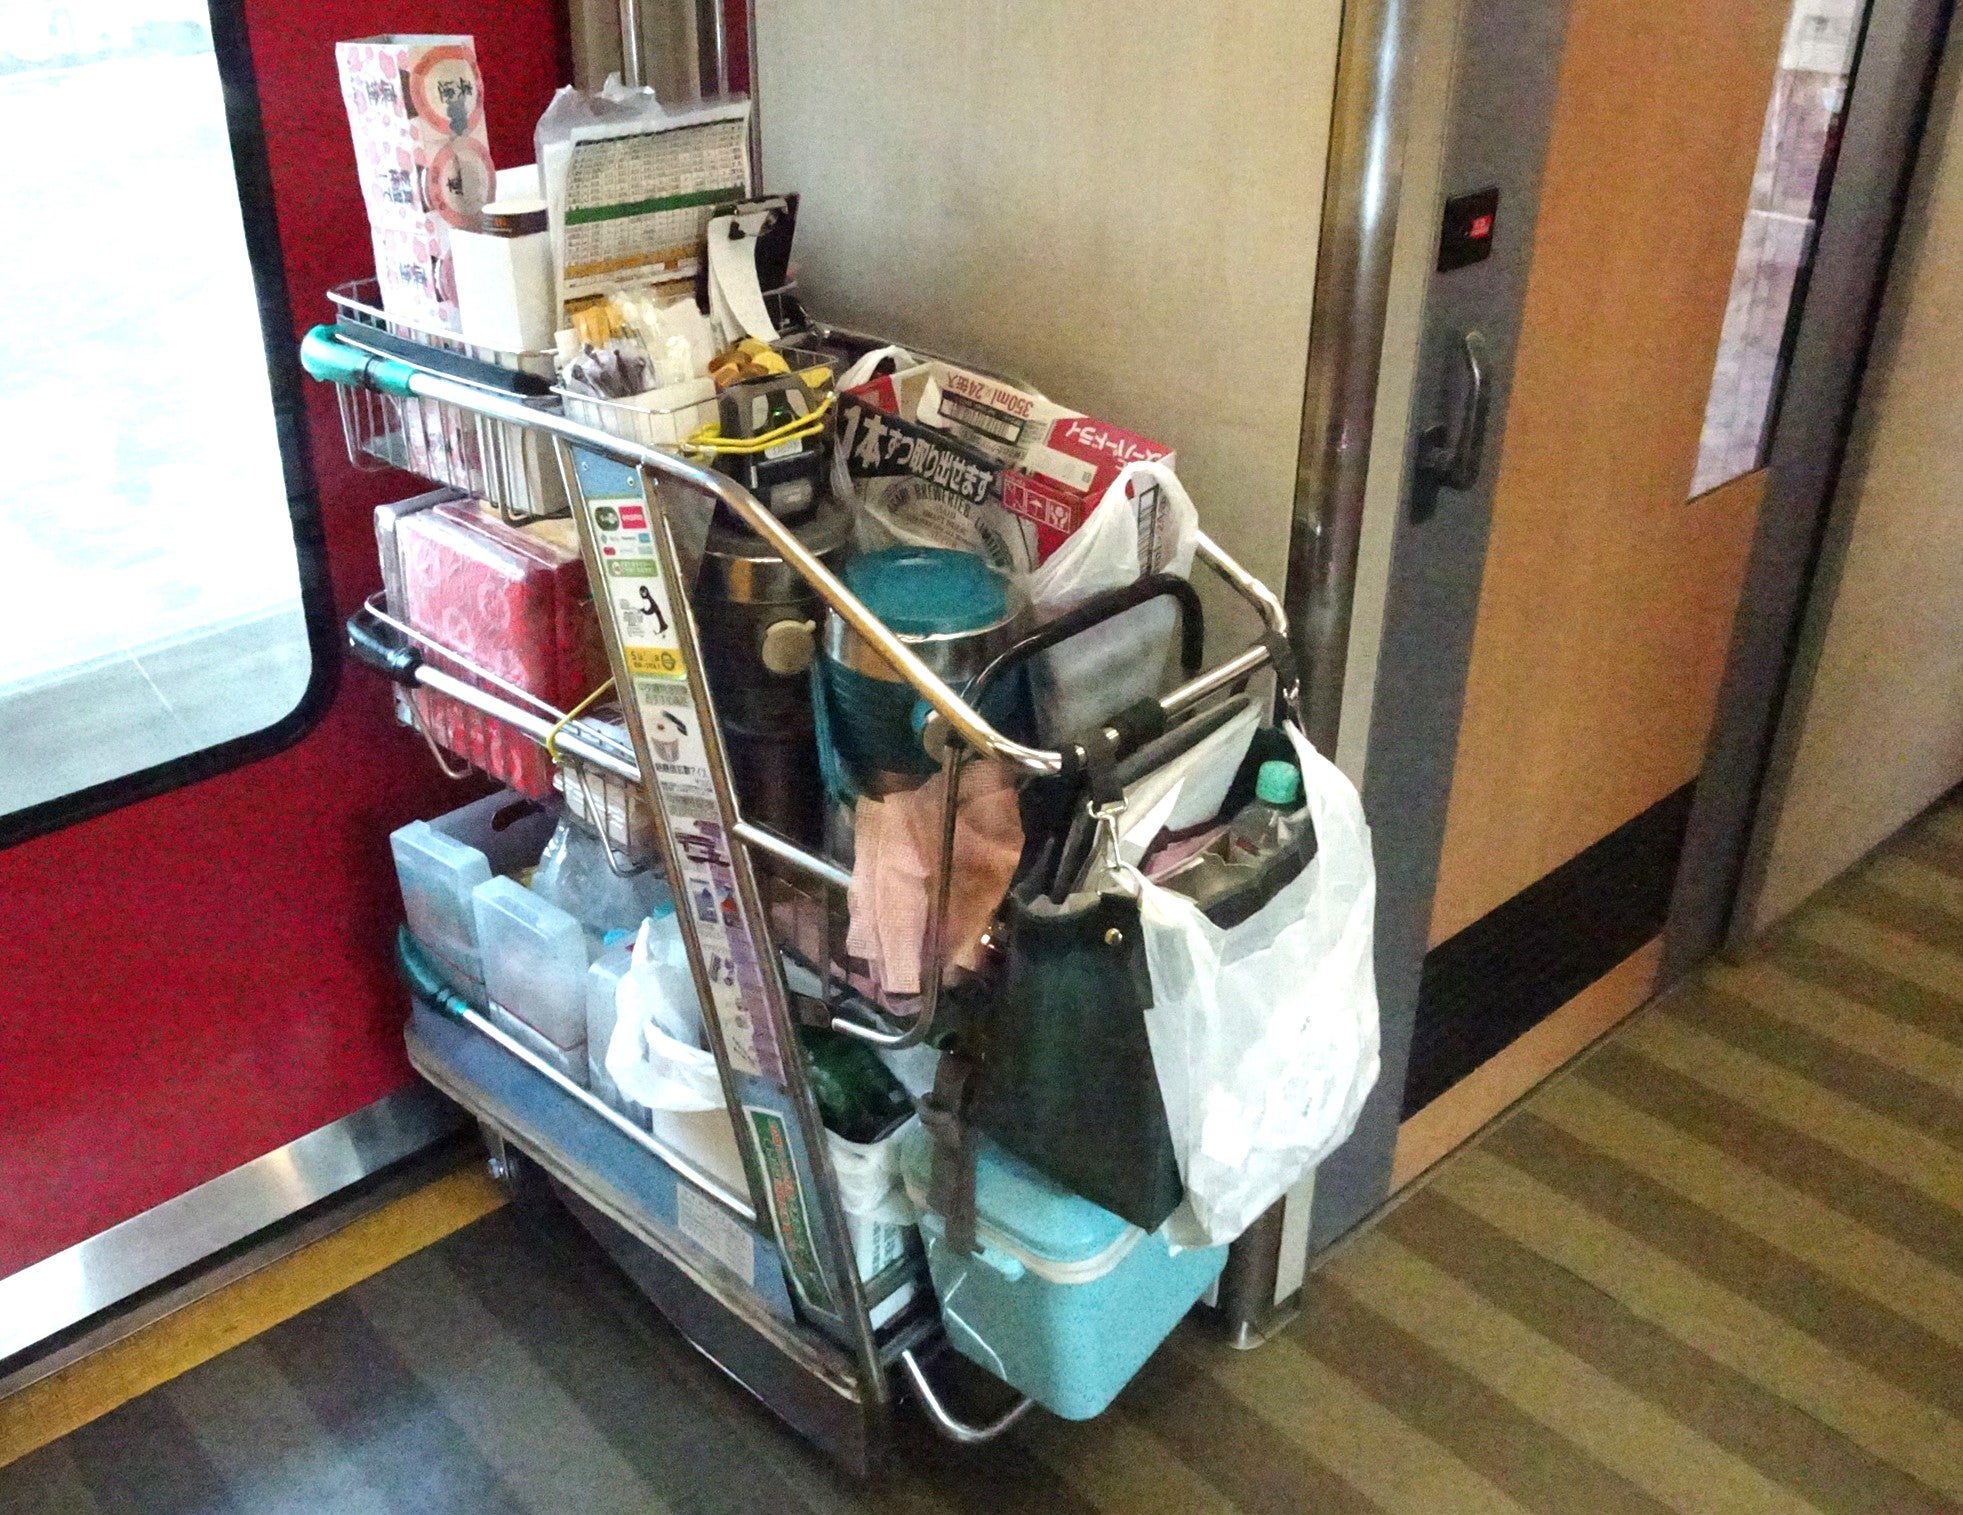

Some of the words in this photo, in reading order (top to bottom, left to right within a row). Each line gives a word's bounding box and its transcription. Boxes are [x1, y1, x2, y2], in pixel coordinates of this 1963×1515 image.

[843, 405, 993, 502] 1本ずつ取り出せます
